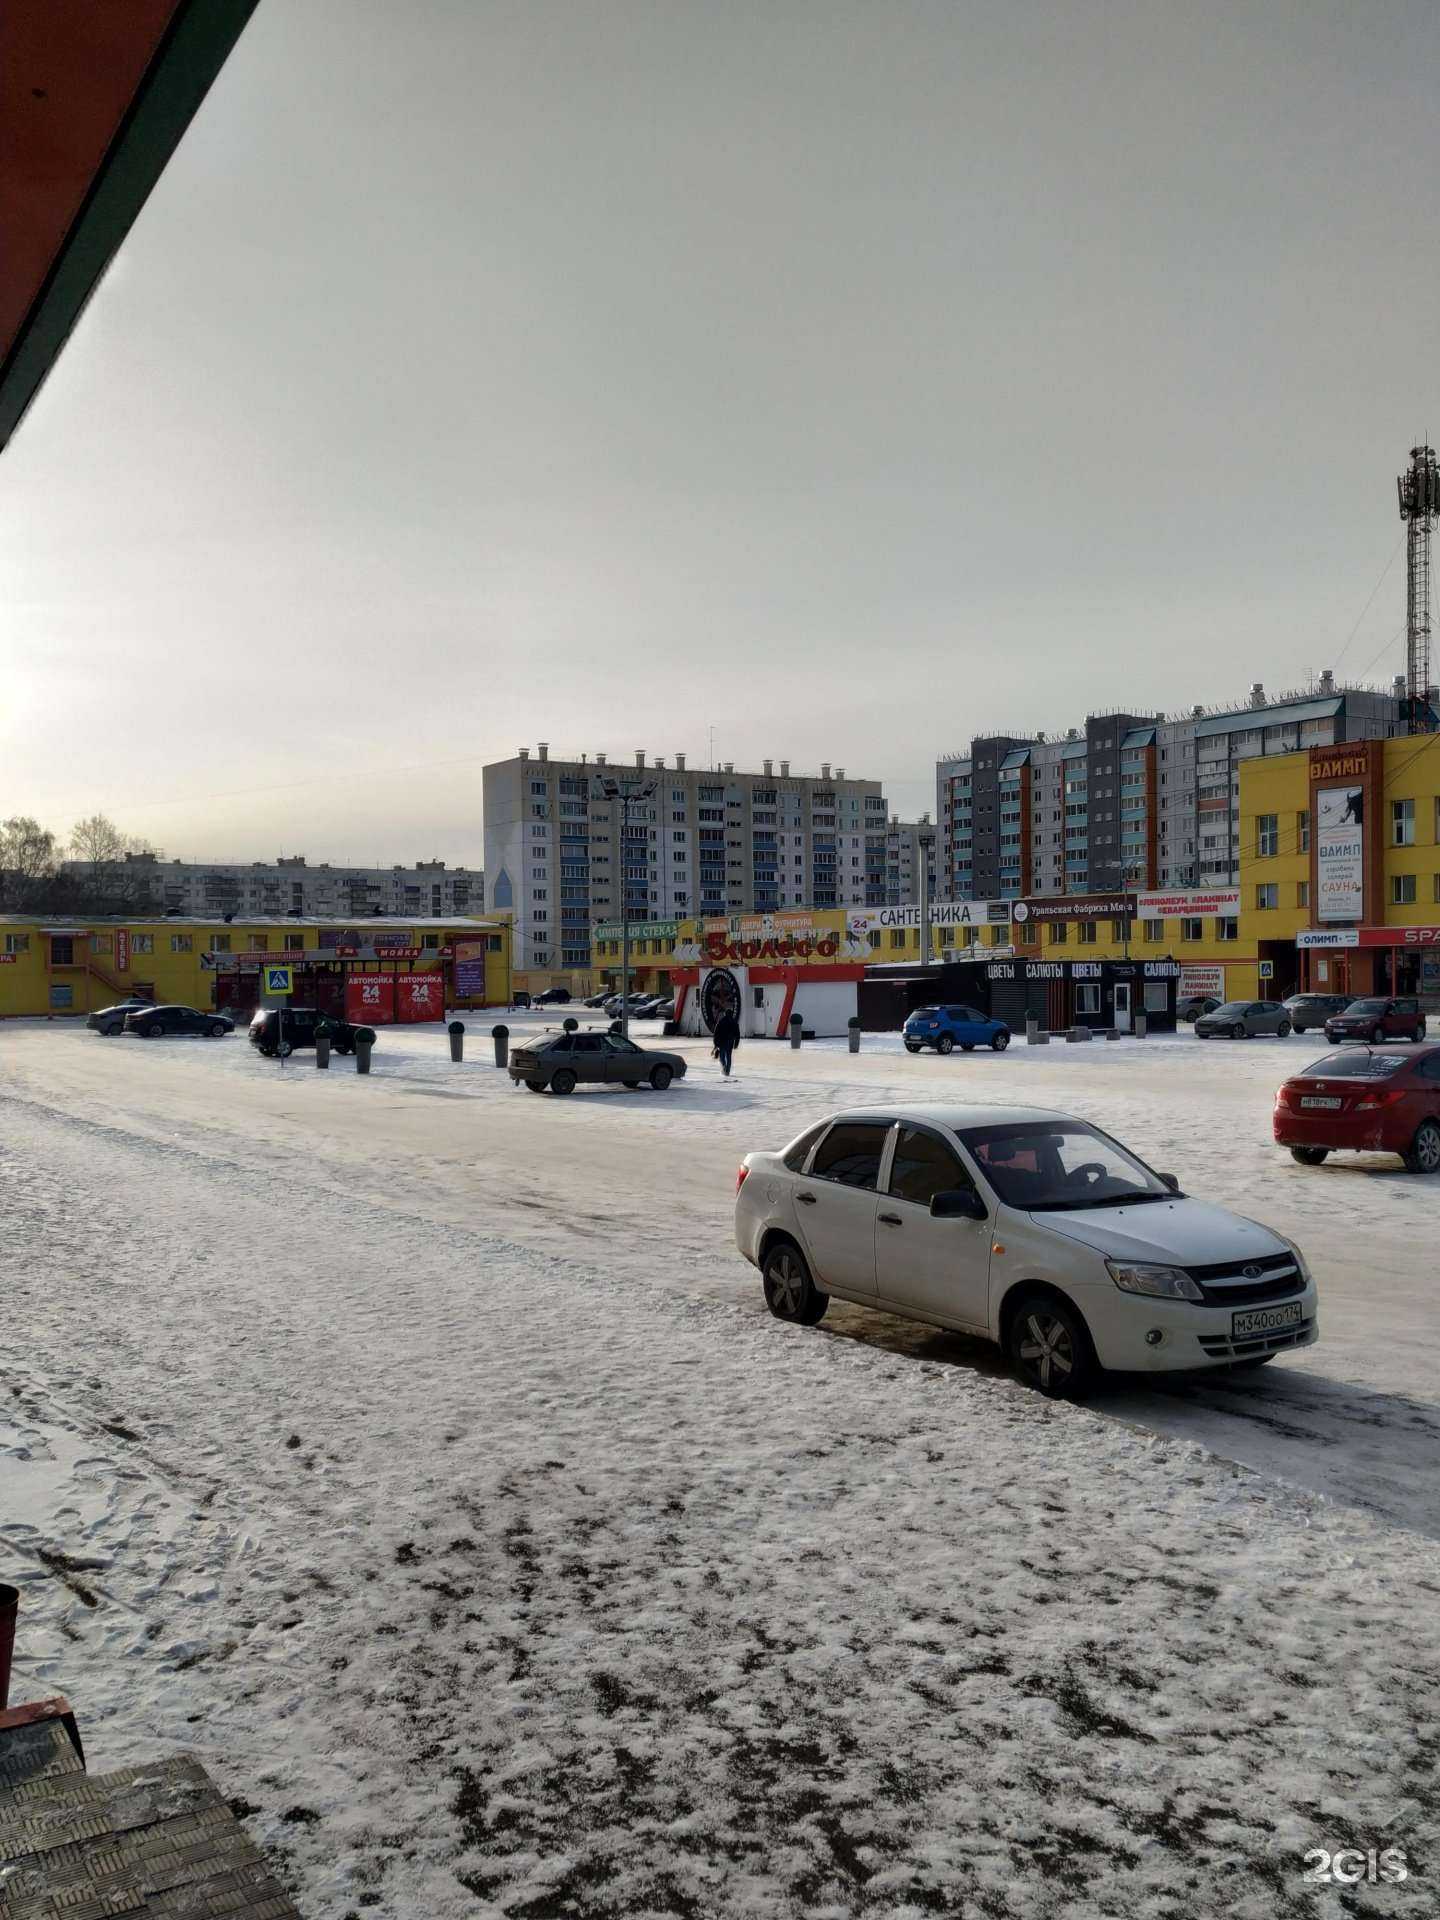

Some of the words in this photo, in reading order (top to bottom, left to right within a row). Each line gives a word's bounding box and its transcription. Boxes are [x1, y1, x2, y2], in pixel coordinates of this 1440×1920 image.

[1321, 881, 1358, 893] САУНА
[1031, 906, 1072, 916] Уральская
[1073, 903, 1108, 914] Фабрика
[853, 919, 867, 929] 24
[1303, 935, 1338, 944] ОЛИМП
[380, 949, 419, 957] МОЙКА
[988, 964, 1014, 978] ЦВЕТЫ
[1026, 964, 1063, 978] САЛЮТЫ
[1071, 963, 1102, 978] ЦВЕТЫ
[1144, 963, 1180, 977] САЛЮТЫ
[348, 976, 393, 984] АВТОМОЙКА
[398, 975, 442, 983] АВТОМОЙКА
[362, 986, 380, 997] 24
[411, 985, 429, 996] 24
